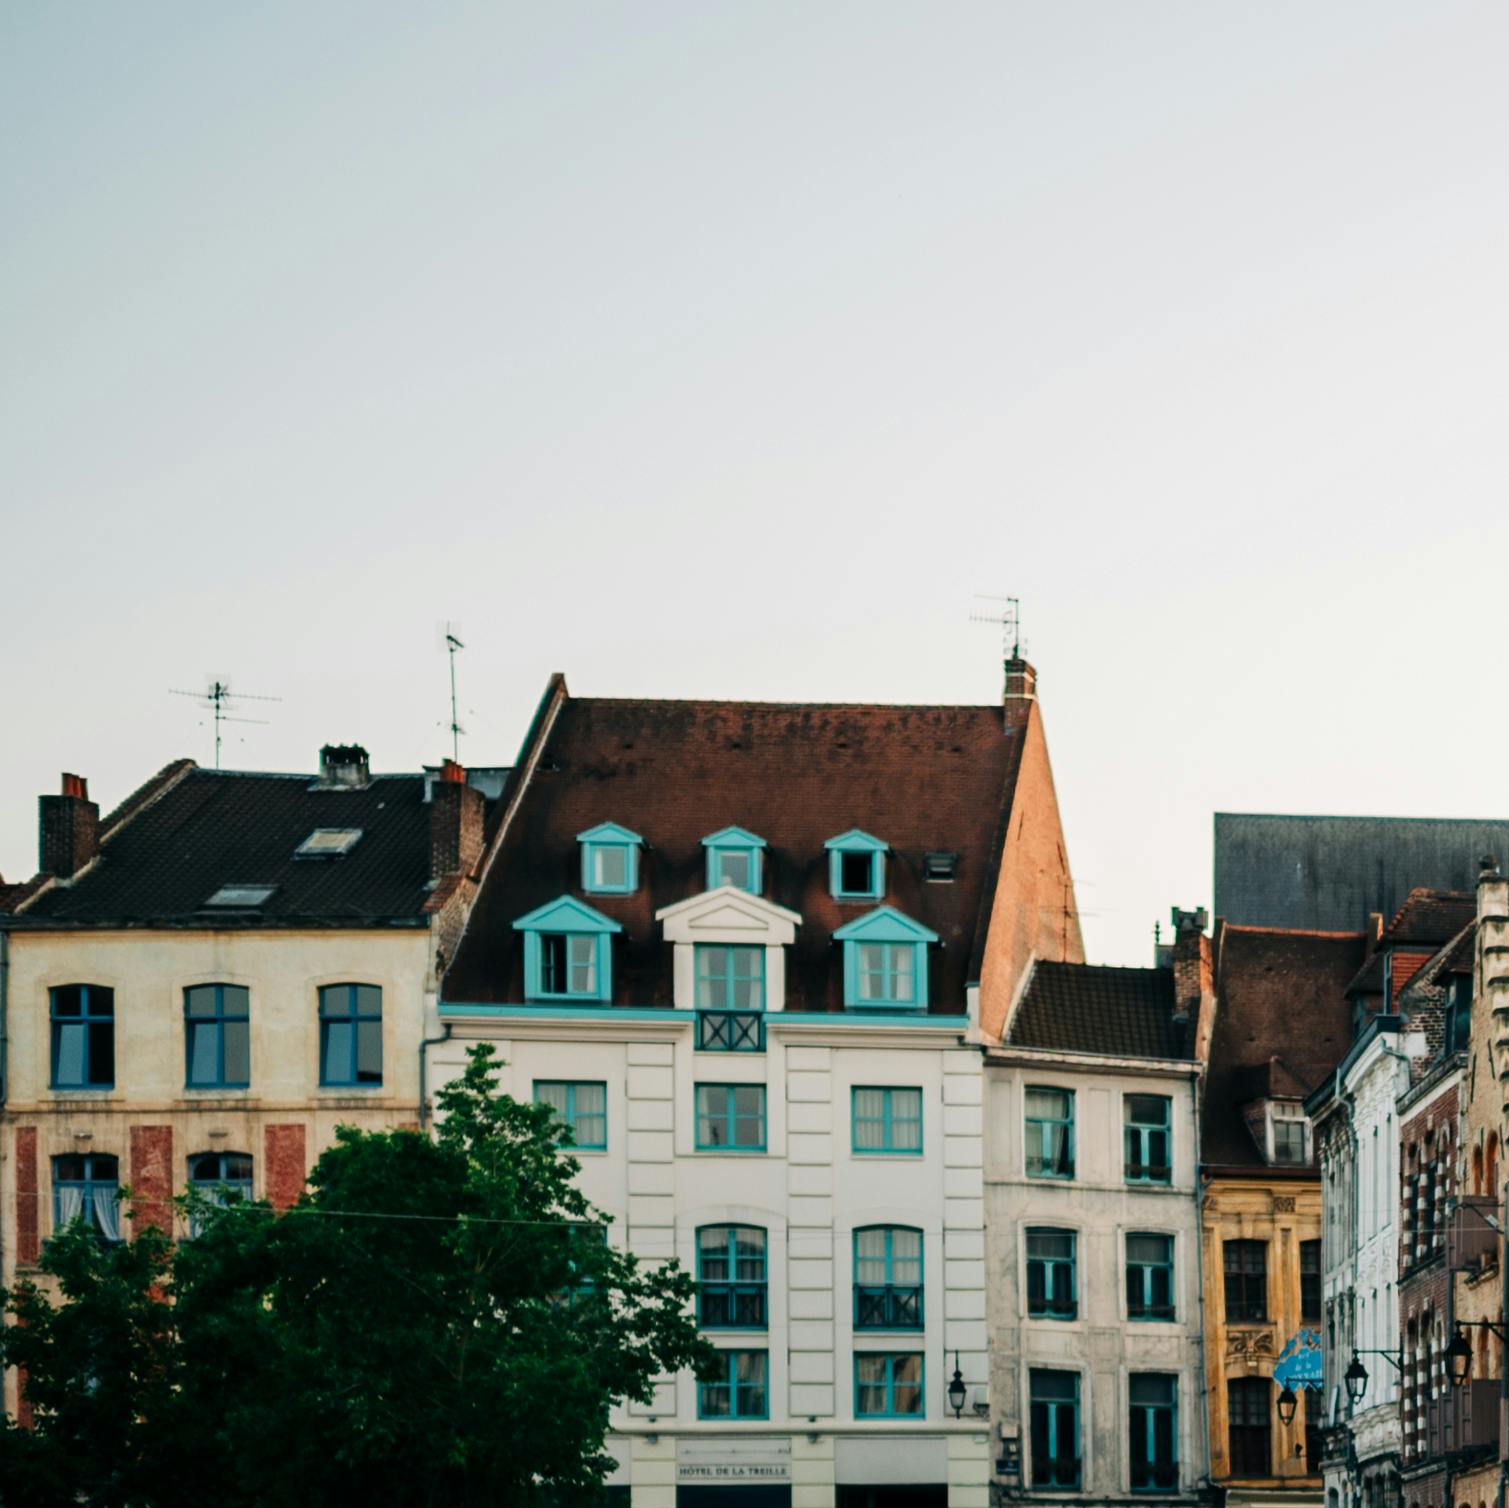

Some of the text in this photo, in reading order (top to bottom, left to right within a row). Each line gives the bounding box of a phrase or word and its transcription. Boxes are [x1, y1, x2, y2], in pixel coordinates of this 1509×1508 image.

[716, 1468, 729, 1476] DE
[732, 1468, 744, 1476] LA
[748, 1467, 787, 1476] TREILLE
